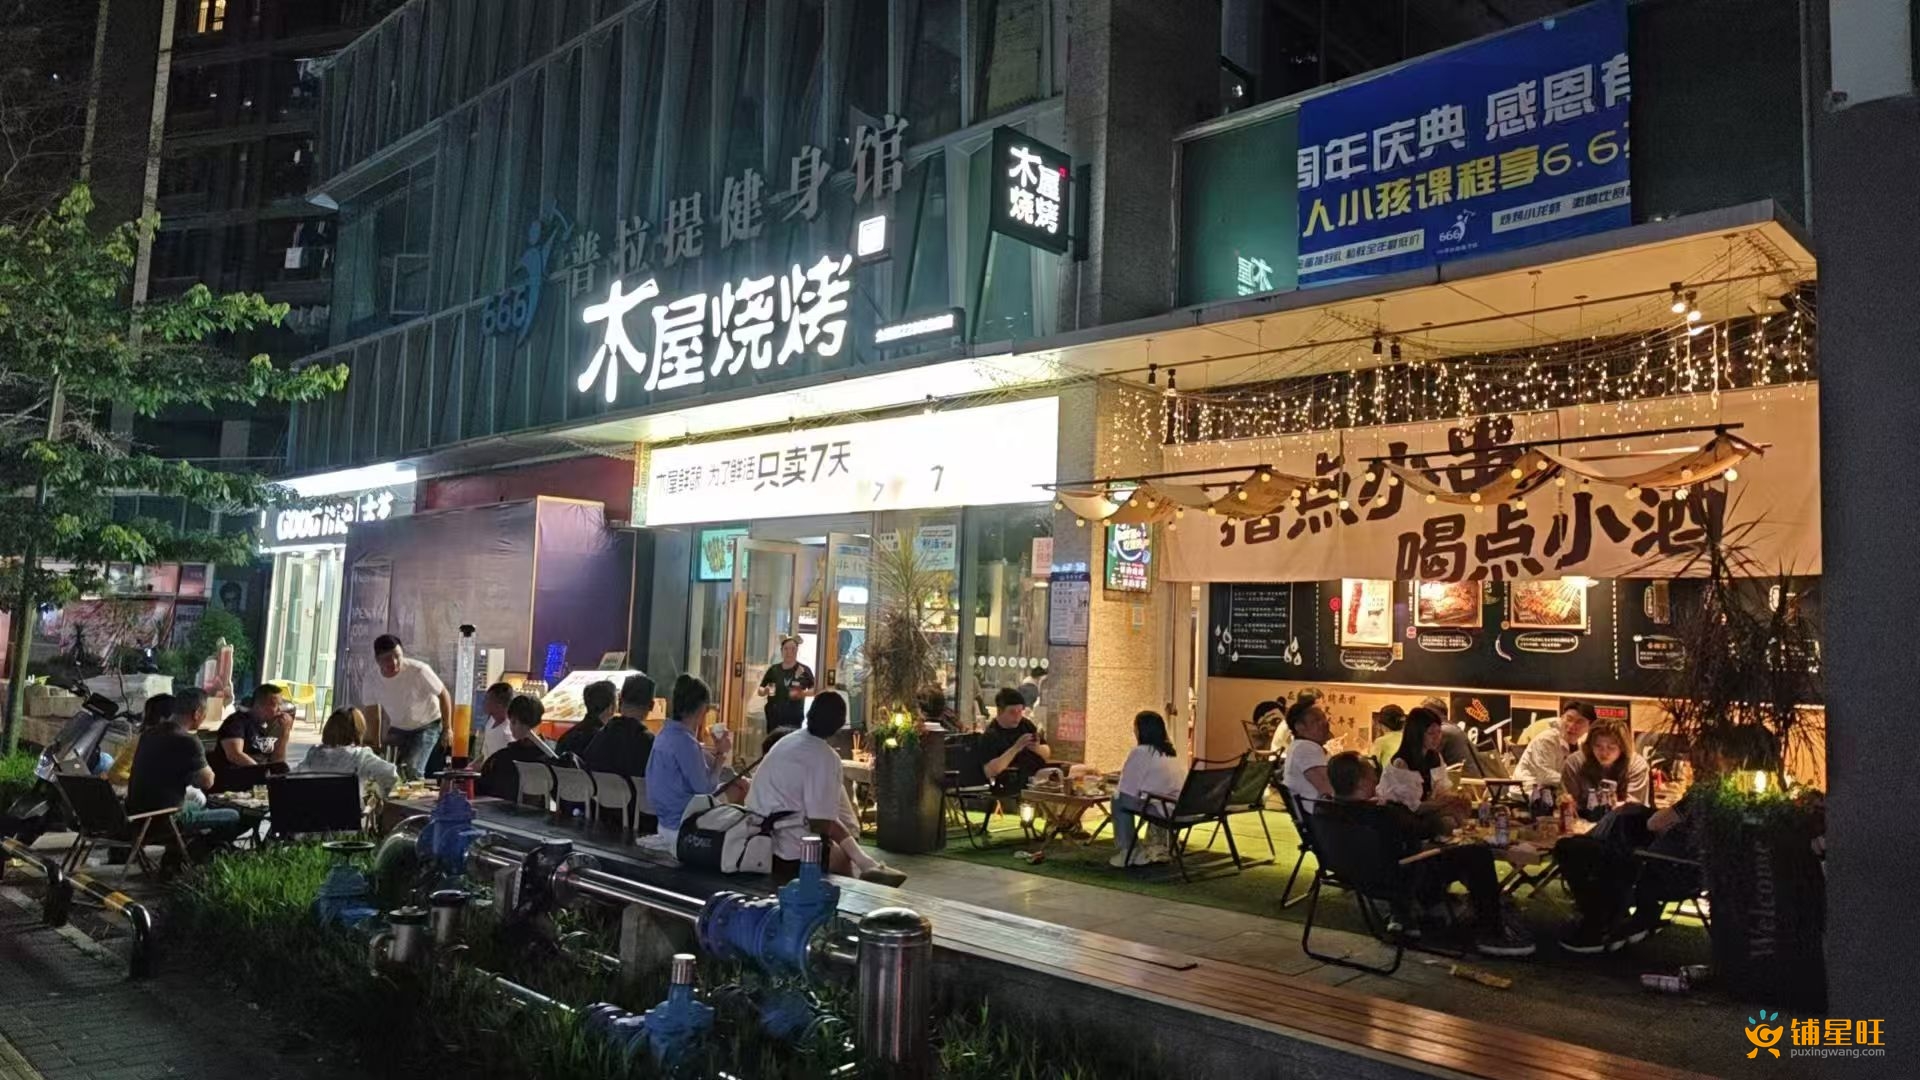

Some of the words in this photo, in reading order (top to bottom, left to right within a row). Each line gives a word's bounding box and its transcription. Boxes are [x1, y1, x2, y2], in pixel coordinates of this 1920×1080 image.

[1009, 146, 1061, 202] 木屋
[1297, 104, 1467, 188] 周年庆典
[1303, 121, 1630, 236] 人小孩课程享6.6
[550, 114, 909, 297] 普拉提健身馆
[1009, 185, 1060, 234] 烧烤
[577, 254, 854, 402] 木屋烧烤
[1397, 484, 1727, 583] 喝点小酒
